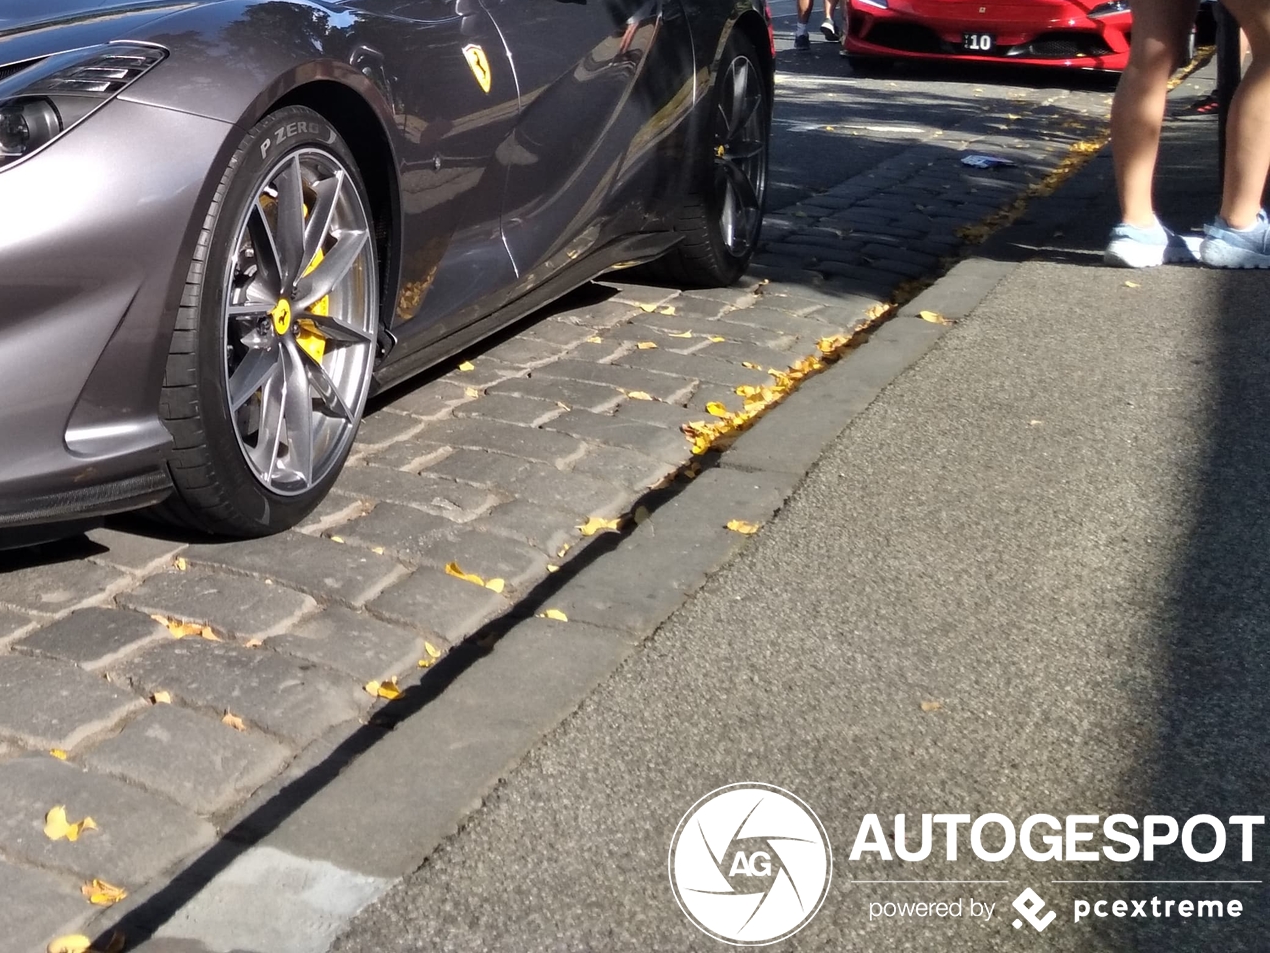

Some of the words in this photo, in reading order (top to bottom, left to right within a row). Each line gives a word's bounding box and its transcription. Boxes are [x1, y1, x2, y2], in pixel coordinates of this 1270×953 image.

[969, 34, 991, 51] 10
[260, 137, 271, 159] P
[274, 121, 320, 145] ZERO
